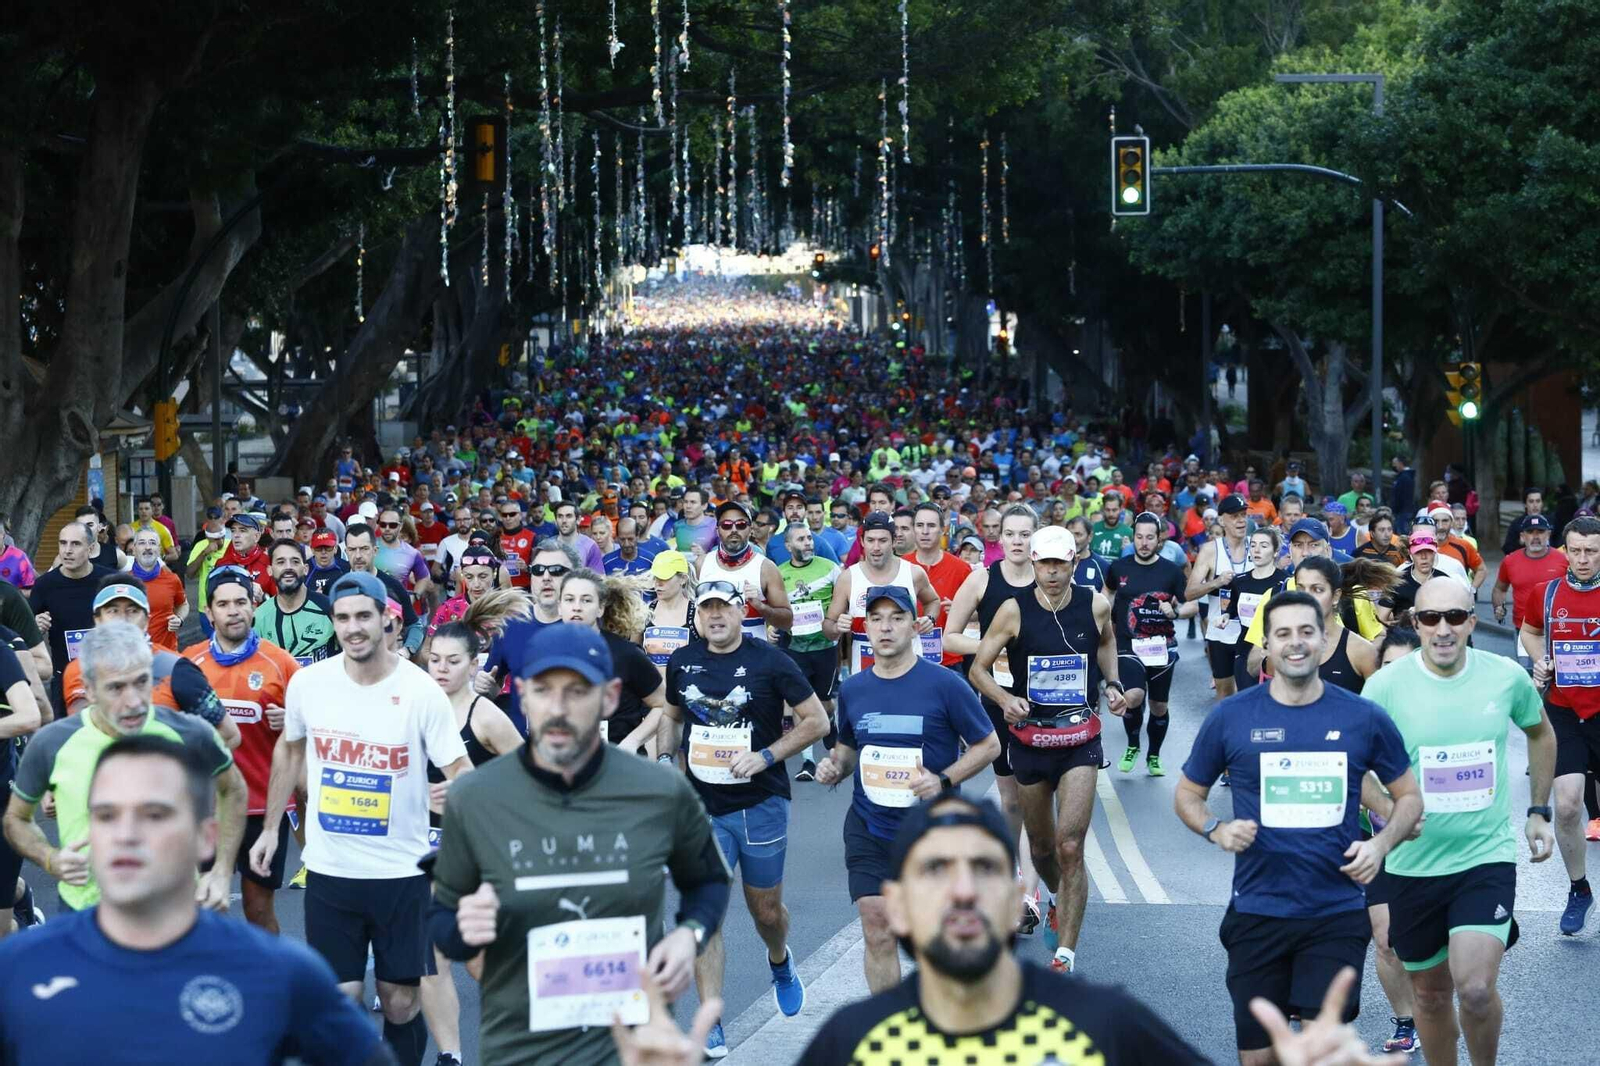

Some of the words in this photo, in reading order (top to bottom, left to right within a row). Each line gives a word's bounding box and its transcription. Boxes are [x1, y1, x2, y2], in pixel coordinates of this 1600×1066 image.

[1575, 658, 1596, 667] 2501
[1054, 673, 1077, 682] 4389
[714, 749, 739, 759] 627
[1450, 749, 1481, 760] ZURICH
[885, 770, 911, 780] 6272
[1456, 768, 1485, 781] 6912
[346, 775, 379, 786] ZURICH
[1299, 780, 1333, 793] 5313
[351, 796, 379, 808] 1684
[509, 832, 629, 858] PUMA
[583, 960, 627, 977] 6614
